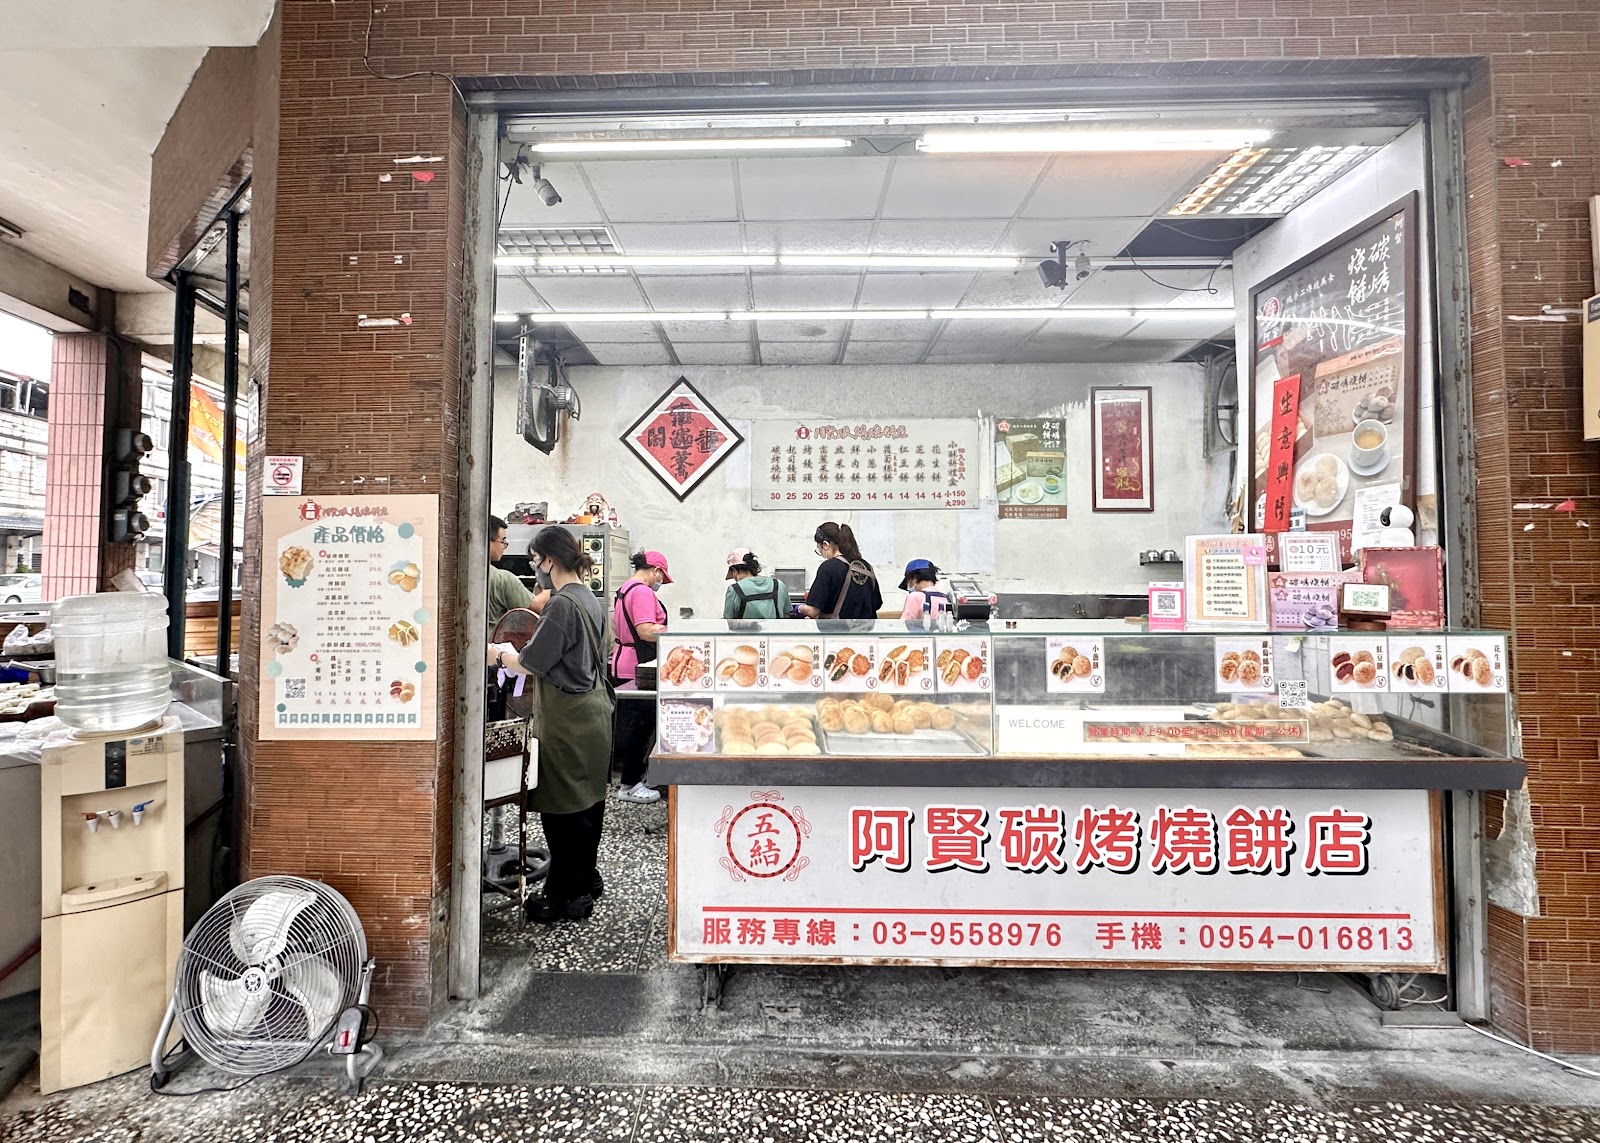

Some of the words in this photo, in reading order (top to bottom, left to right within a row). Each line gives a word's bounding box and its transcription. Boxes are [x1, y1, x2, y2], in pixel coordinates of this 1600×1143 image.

[770, 492, 781, 500] 30
[786, 492, 797, 500] 25
[802, 492, 813, 500] 20
[818, 492, 829, 500] 25
[834, 492, 845, 500] 25
[850, 492, 861, 500] 20
[866, 492, 877, 500] 14
[883, 492, 893, 500] 14
[899, 492, 909, 500] 14
[915, 492, 926, 500] 14
[931, 492, 942, 500] 14
[313, 525, 385, 544] 產品價格
[1299, 545, 1330, 554] 10元
[1009, 719, 1065, 728] WELCOME
[748, 813, 780, 868] 五結
[850, 806, 1370, 873] 阿賢碳烤燒餅店
